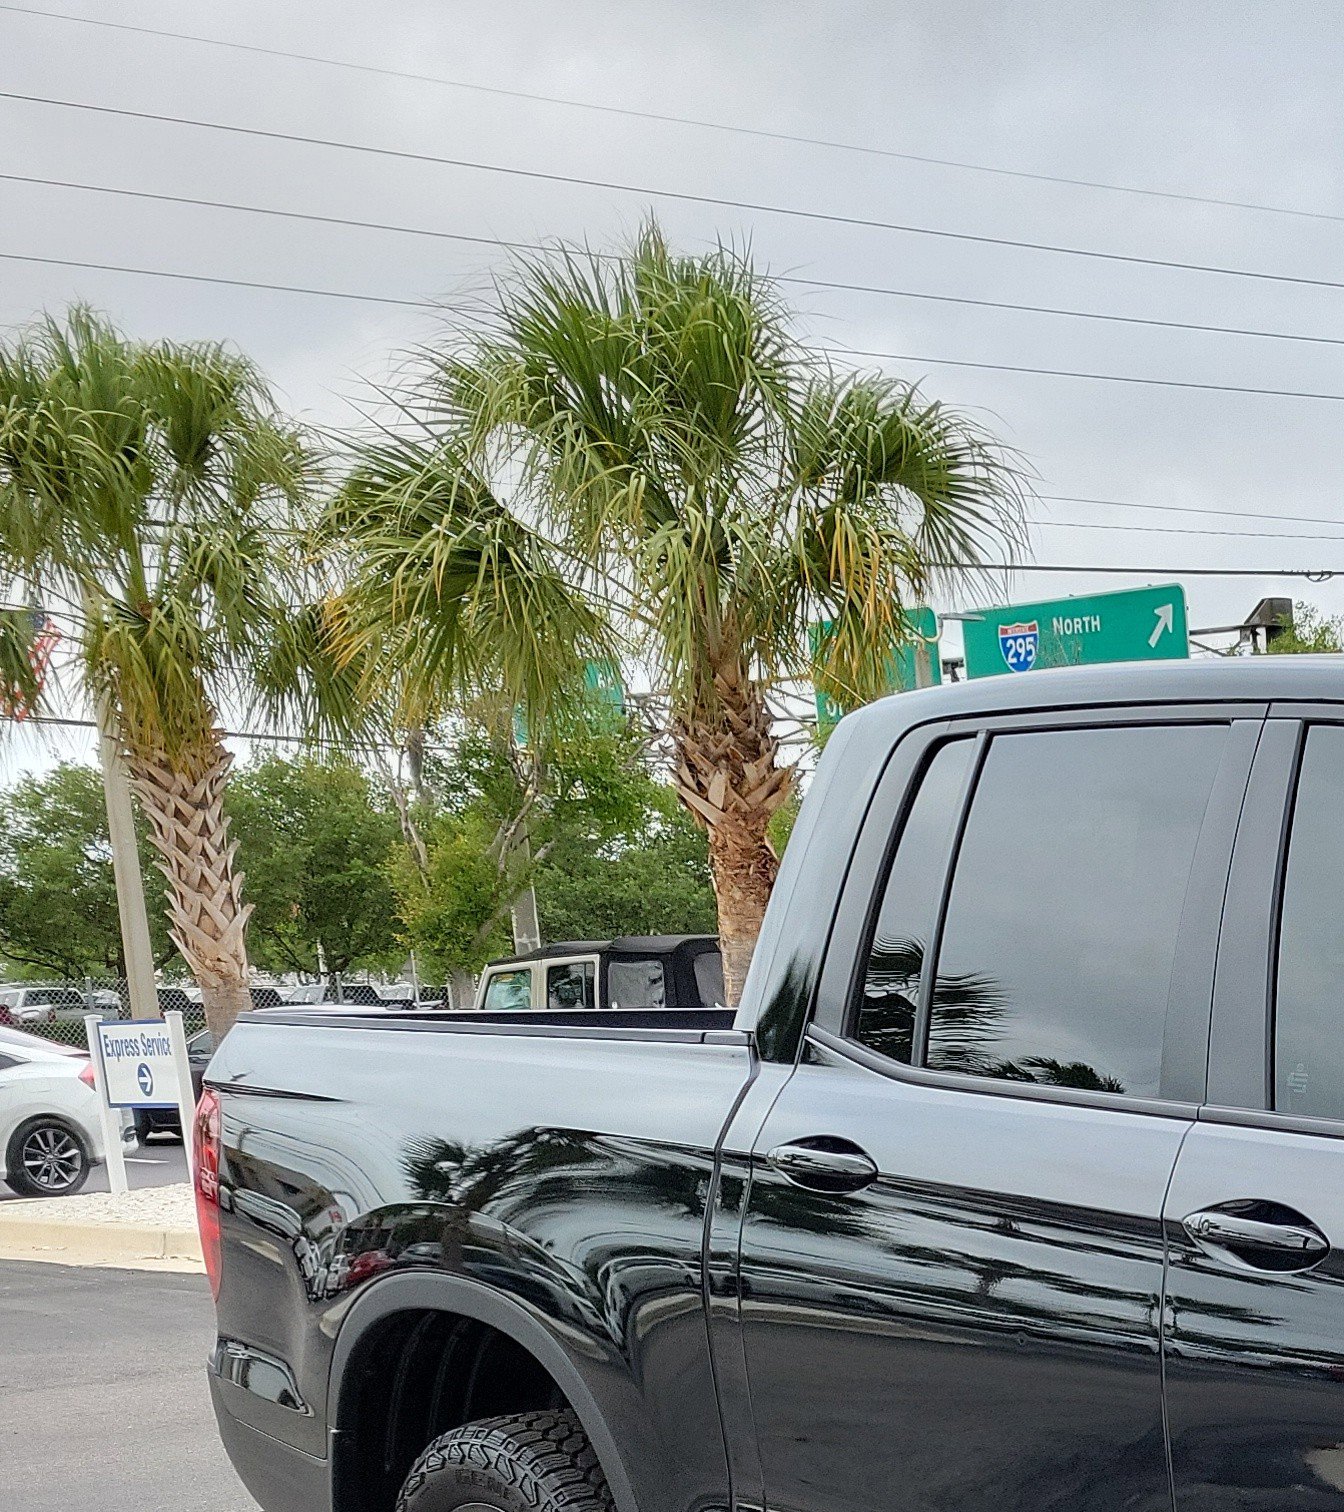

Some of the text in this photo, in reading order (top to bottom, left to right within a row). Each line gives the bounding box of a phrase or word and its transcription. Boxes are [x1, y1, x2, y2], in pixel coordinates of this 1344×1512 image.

[1052, 615, 1101, 635] NORTH
[1006, 637, 1035, 664] 295
[103, 1034, 139, 1062] Express
